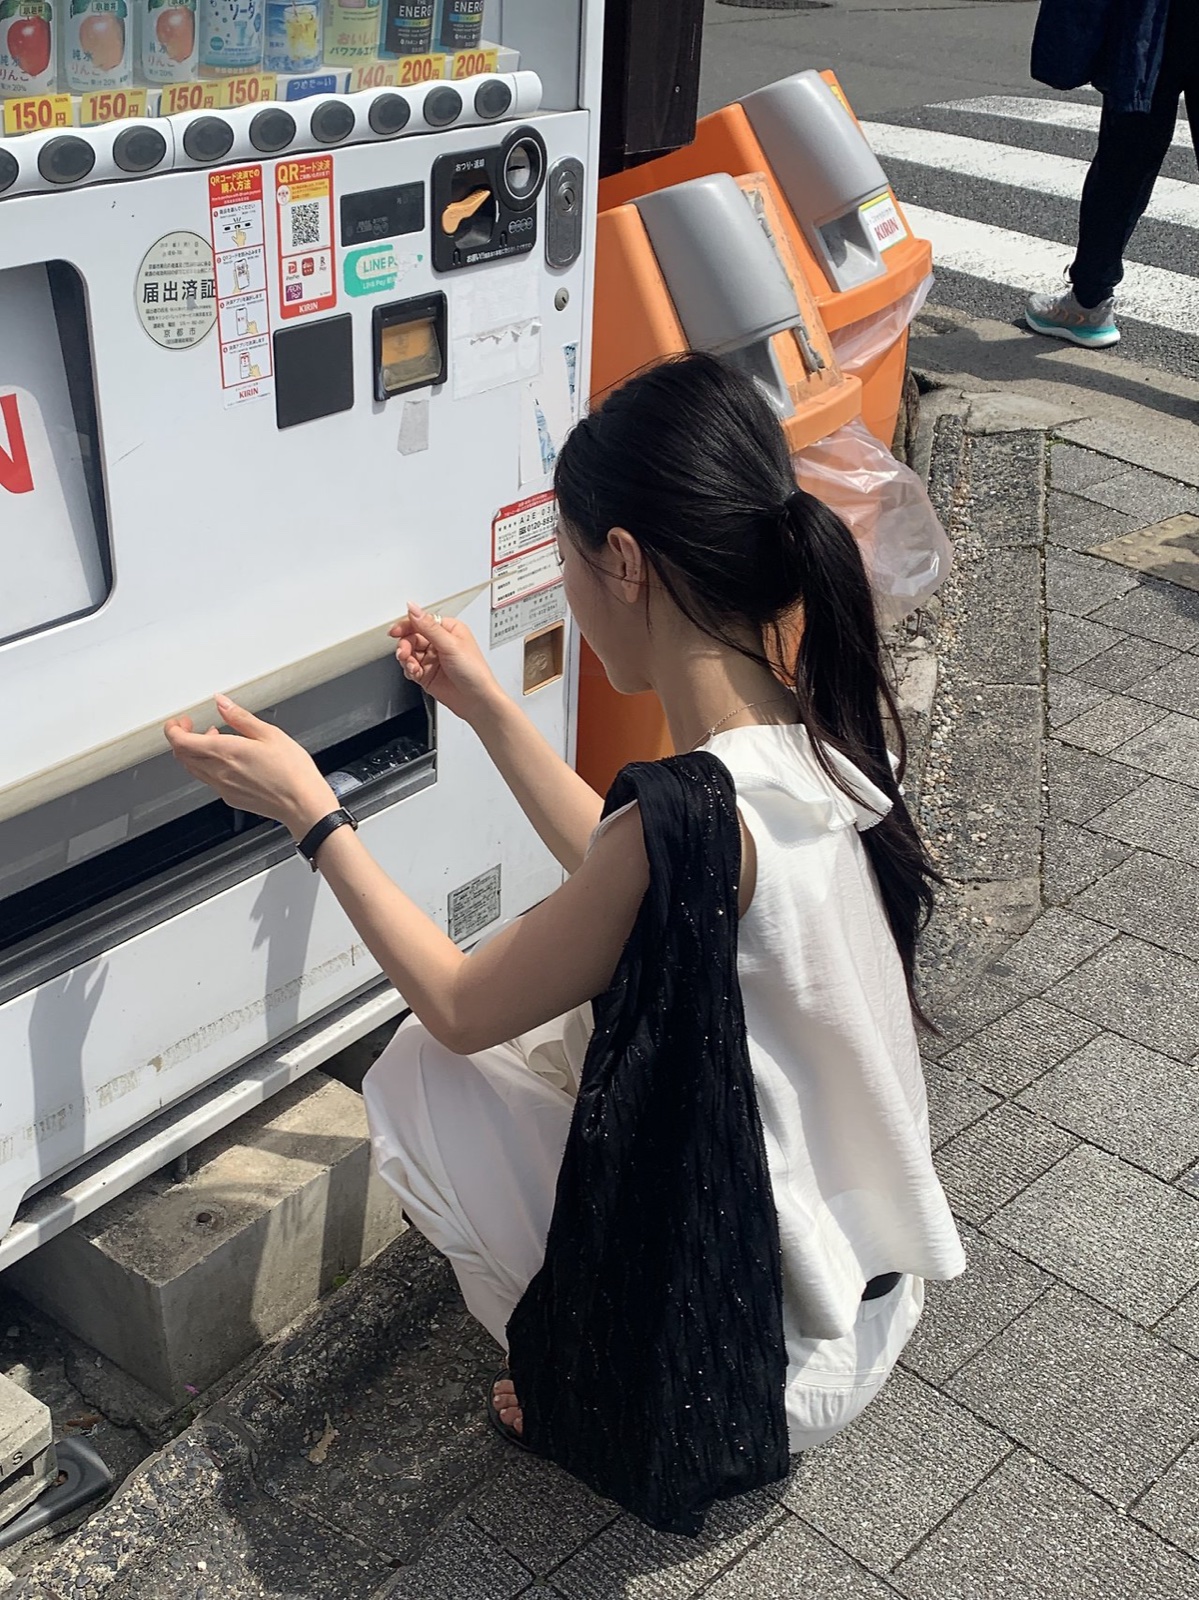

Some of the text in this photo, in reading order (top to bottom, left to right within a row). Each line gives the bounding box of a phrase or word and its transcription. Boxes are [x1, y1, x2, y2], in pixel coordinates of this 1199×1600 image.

[221, 180, 252, 194] 購入方法
[874, 218, 899, 242] KIRIN
[363, 257, 386, 273] LINE
[143, 279, 217, 304] 届出済証
[298, 302, 319, 313] KIRIN
[239, 387, 259, 399] KIRIN
